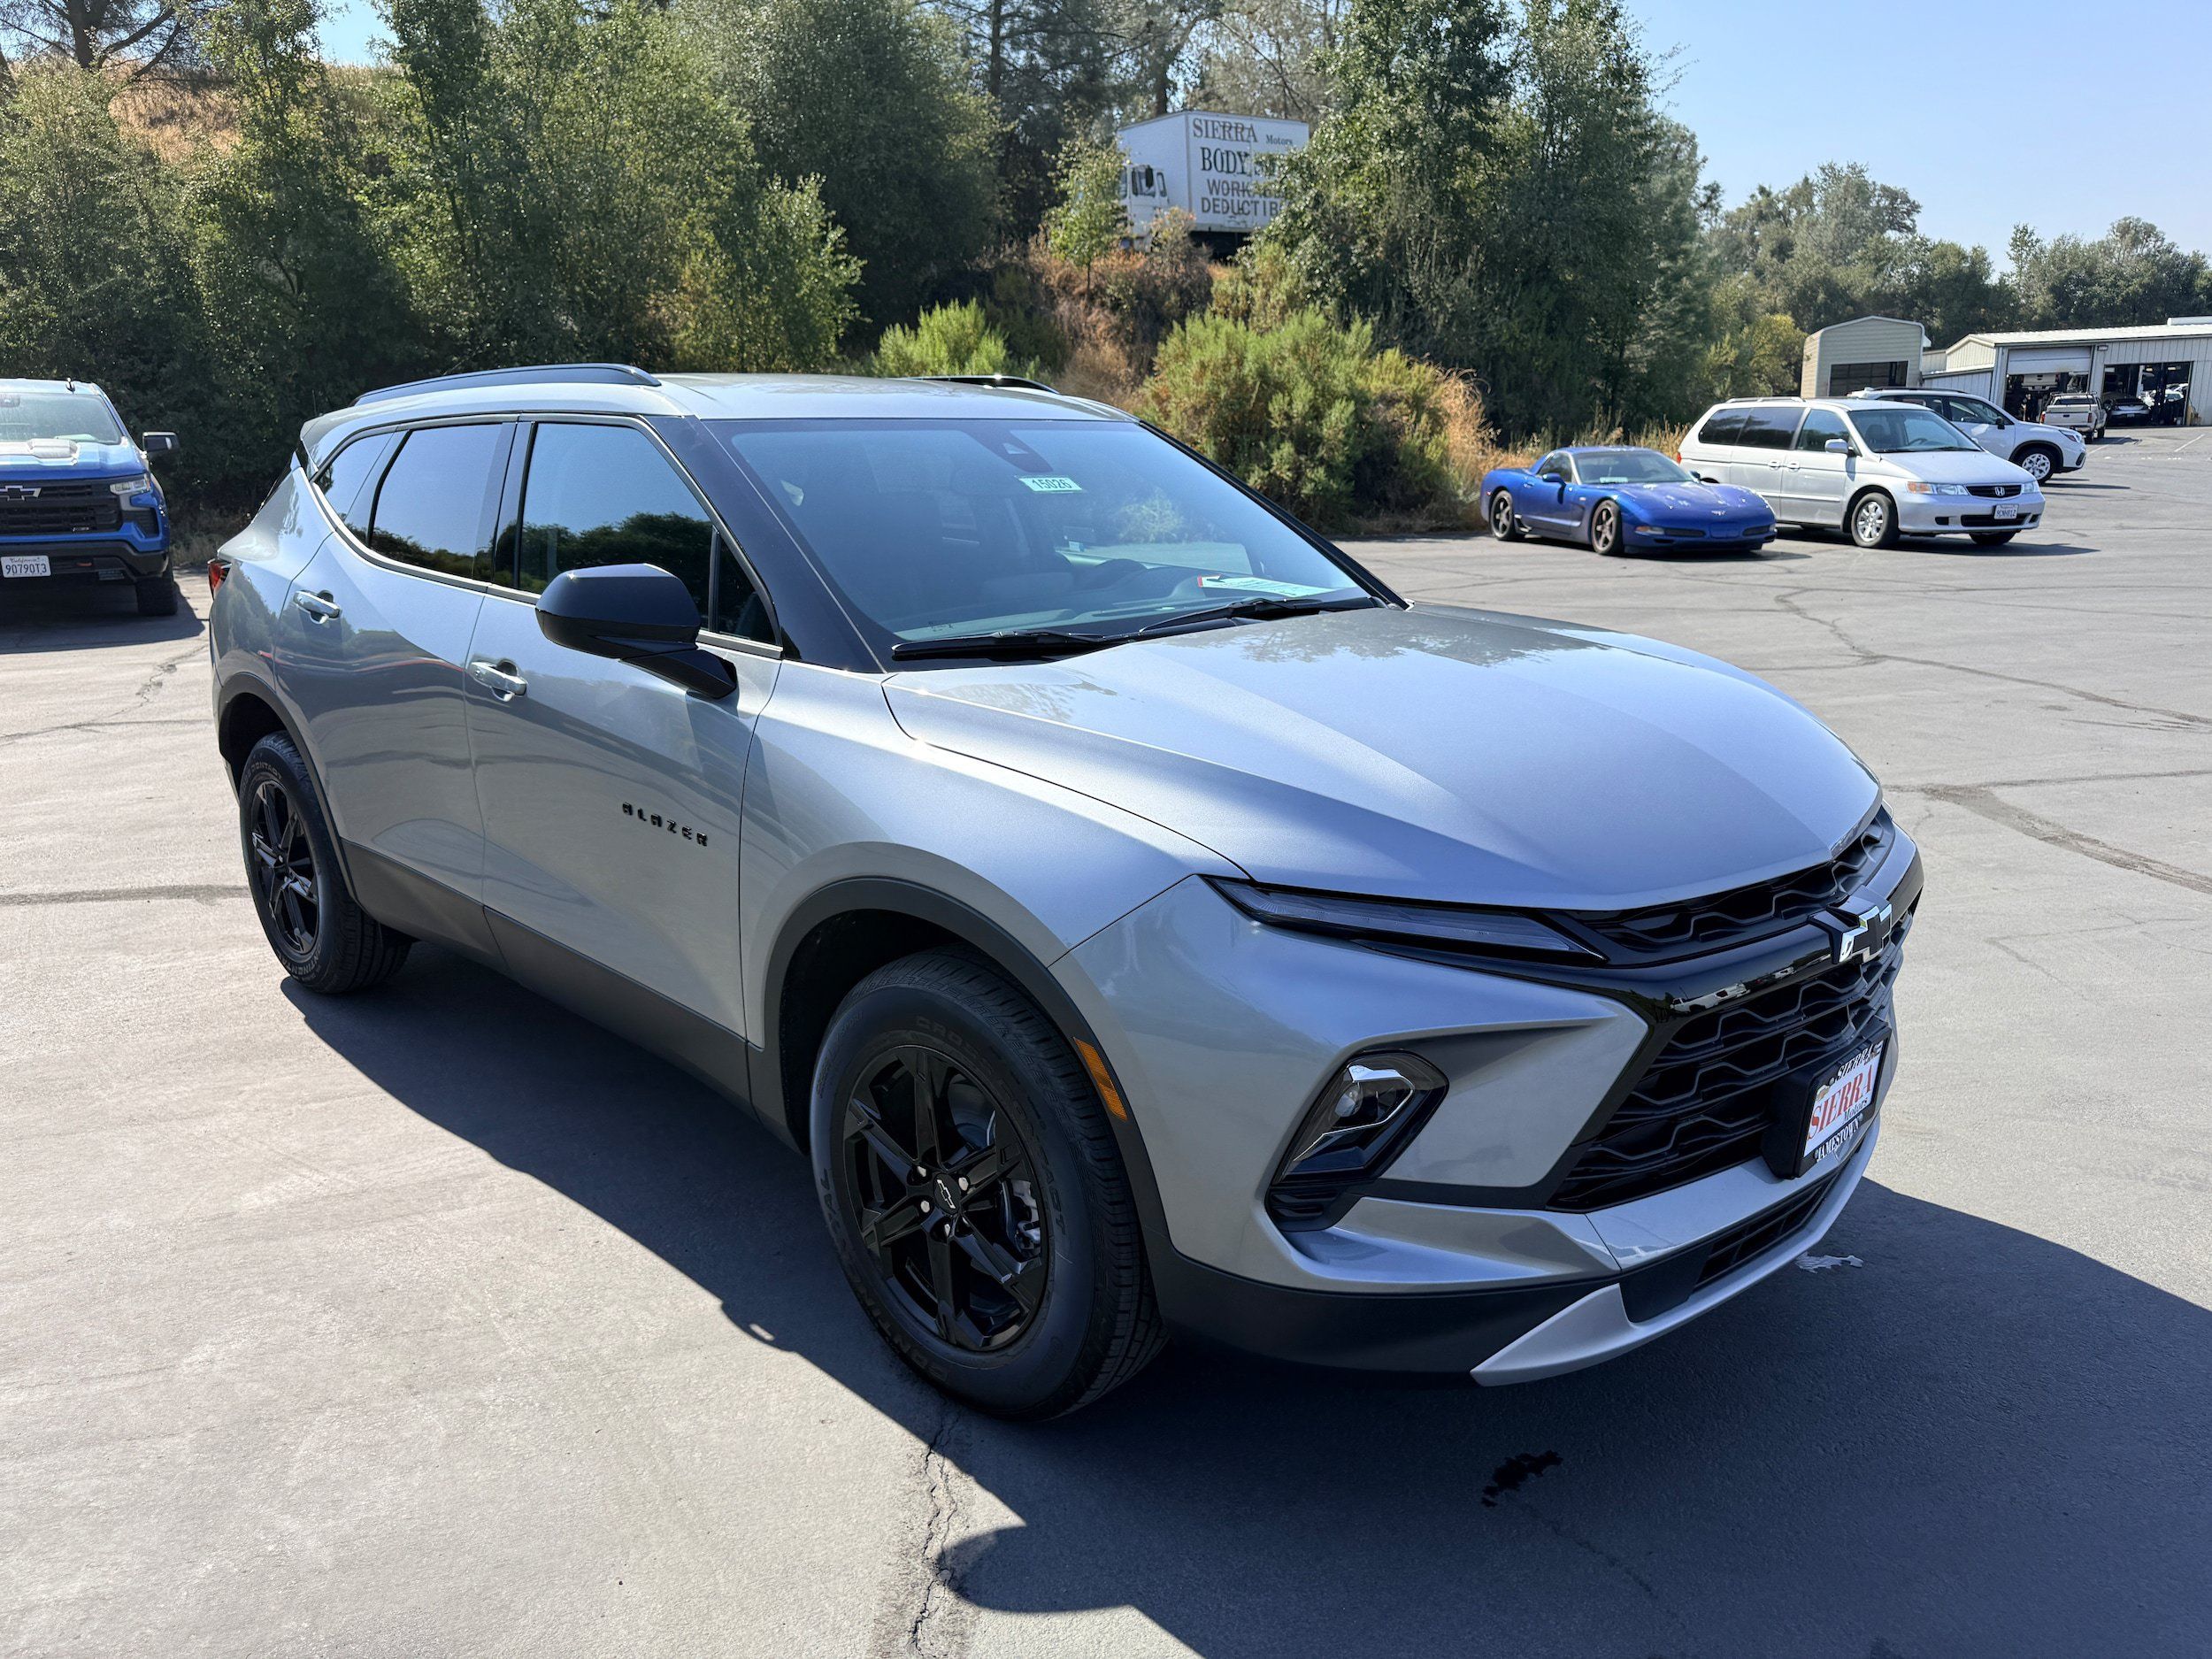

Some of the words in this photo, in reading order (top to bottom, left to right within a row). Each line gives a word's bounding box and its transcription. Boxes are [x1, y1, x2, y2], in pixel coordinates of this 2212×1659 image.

[1193, 118, 1258, 142] SIERRA
[1266, 134, 1294, 145] Motors
[1201, 146, 1250, 175] BODY
[1201, 197, 1282, 217] DEDUCTIB
[5, 563, 47, 574] 90790T3
[622, 802, 708, 847] BLAZER
[1806, 1065, 1872, 1141] SIERRA
[1845, 1097, 1868, 1121] Motors
[1816, 1117, 1860, 1162] JAMESTOWN
